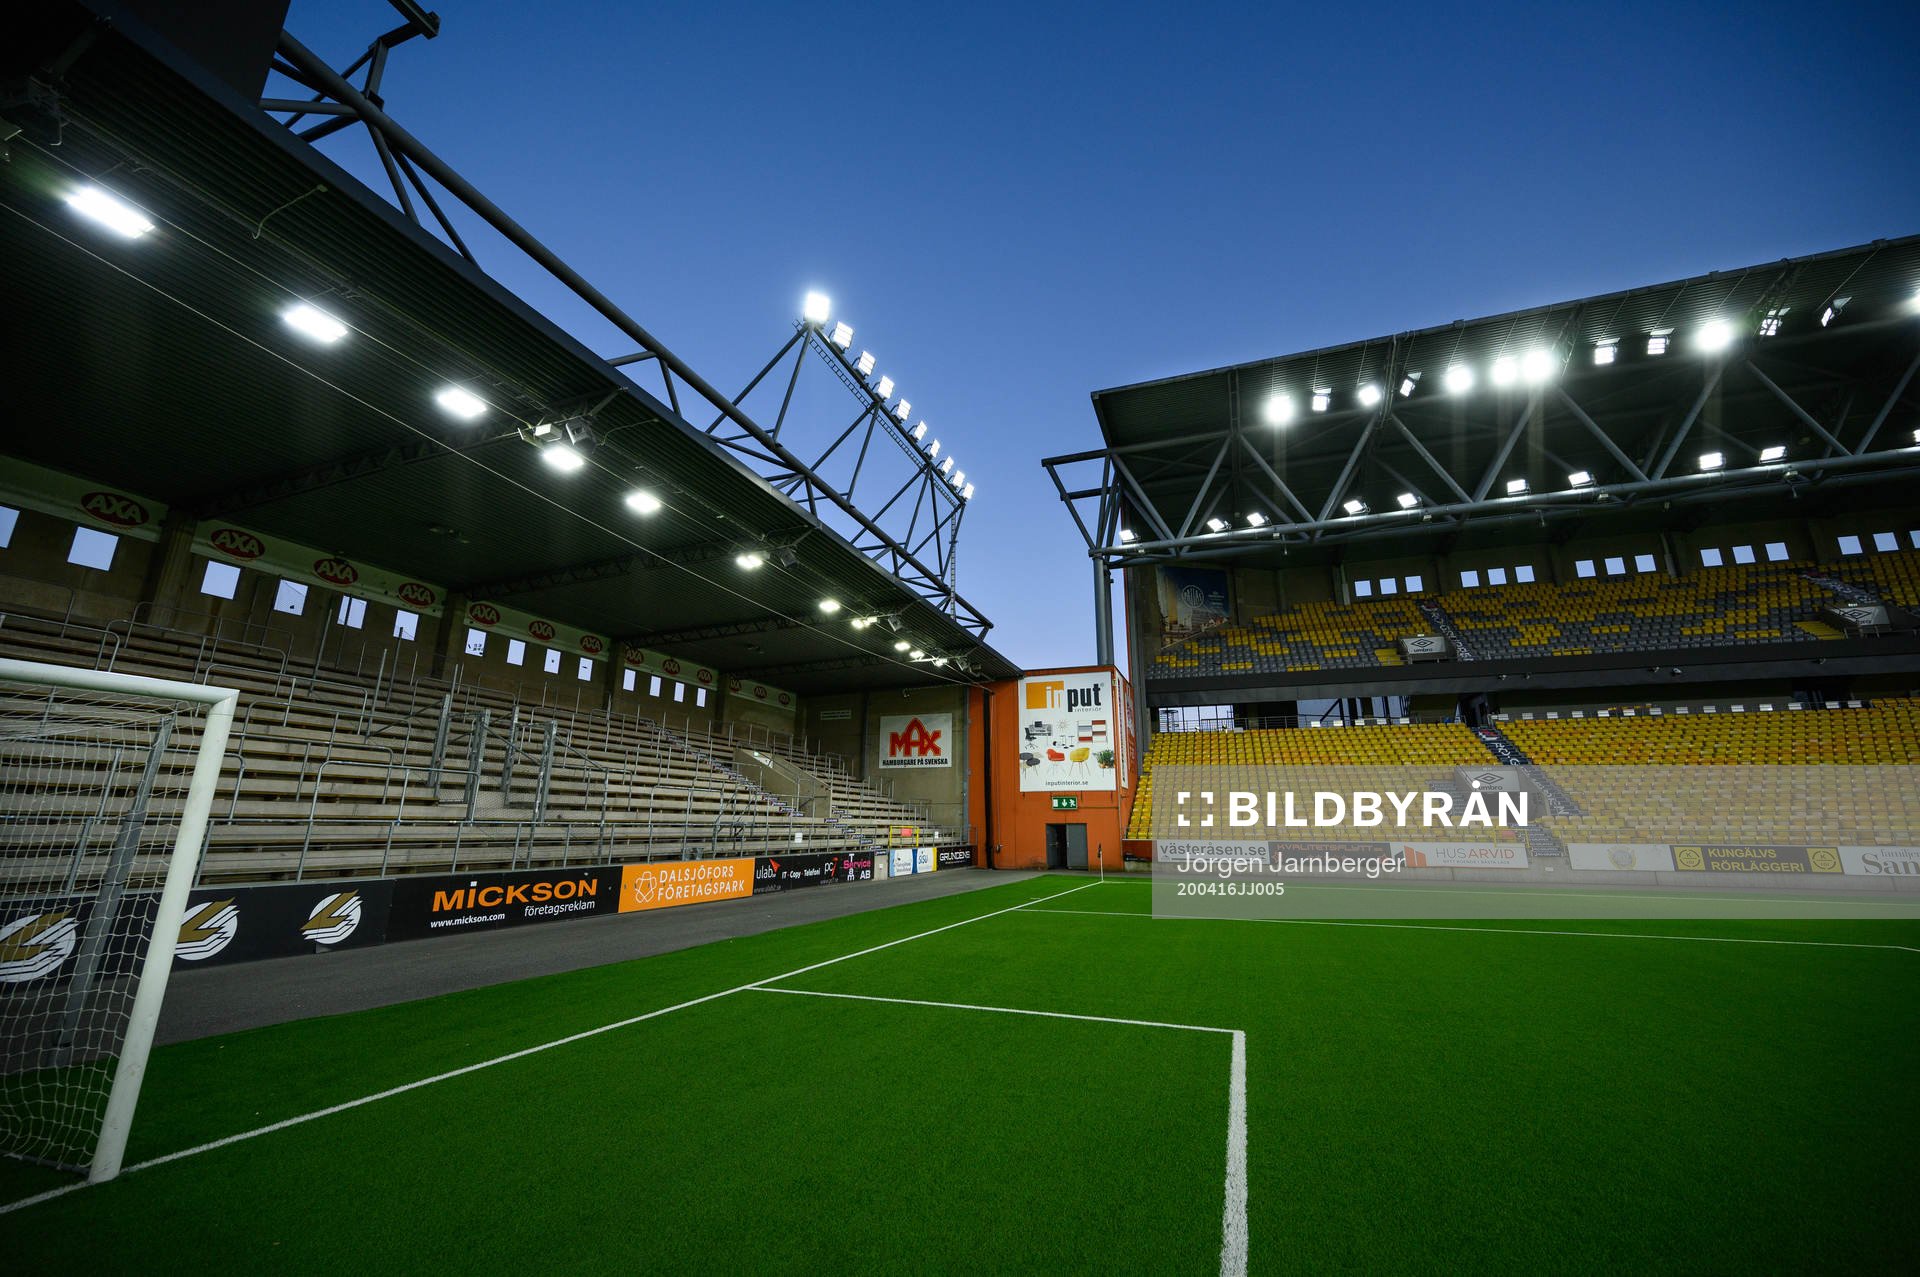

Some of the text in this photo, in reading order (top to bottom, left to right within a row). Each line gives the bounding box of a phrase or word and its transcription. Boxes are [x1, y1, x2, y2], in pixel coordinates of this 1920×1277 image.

[86, 494, 143, 524] AXA
[215, 531, 260, 556] AXA
[317, 560, 354, 582] AXA
[402, 585, 434, 604] AXA
[472, 605, 498, 623] AXA
[531, 622, 554, 638] AXA
[582, 637, 601, 650] AXA
[664, 660, 679, 673] AXA
[888, 717, 942, 757] MAX
[882, 757, 949, 766] HAMBURGARE PÅ SVENSKA
[1160, 841, 1267, 857] västeråsen.se
[1436, 848, 1515, 859] HUSARVID
[1708, 847, 1777, 859] KUNGÄLVS
[843, 859, 871, 870] Service
[918, 854, 928, 865] SISU
[1711, 860, 1805, 872] RÖRLÄGGERI
[659, 865, 734, 883] DALSJÖFORS
[782, 871, 788, 880] IT
[789, 870, 801, 880] Copy
[860, 870, 871, 880] AB
[657, 879, 745, 901] FÖRETAGSPARK
[524, 899, 595, 917] företagsreklam
[430, 912, 505, 928] www.mickson.com
